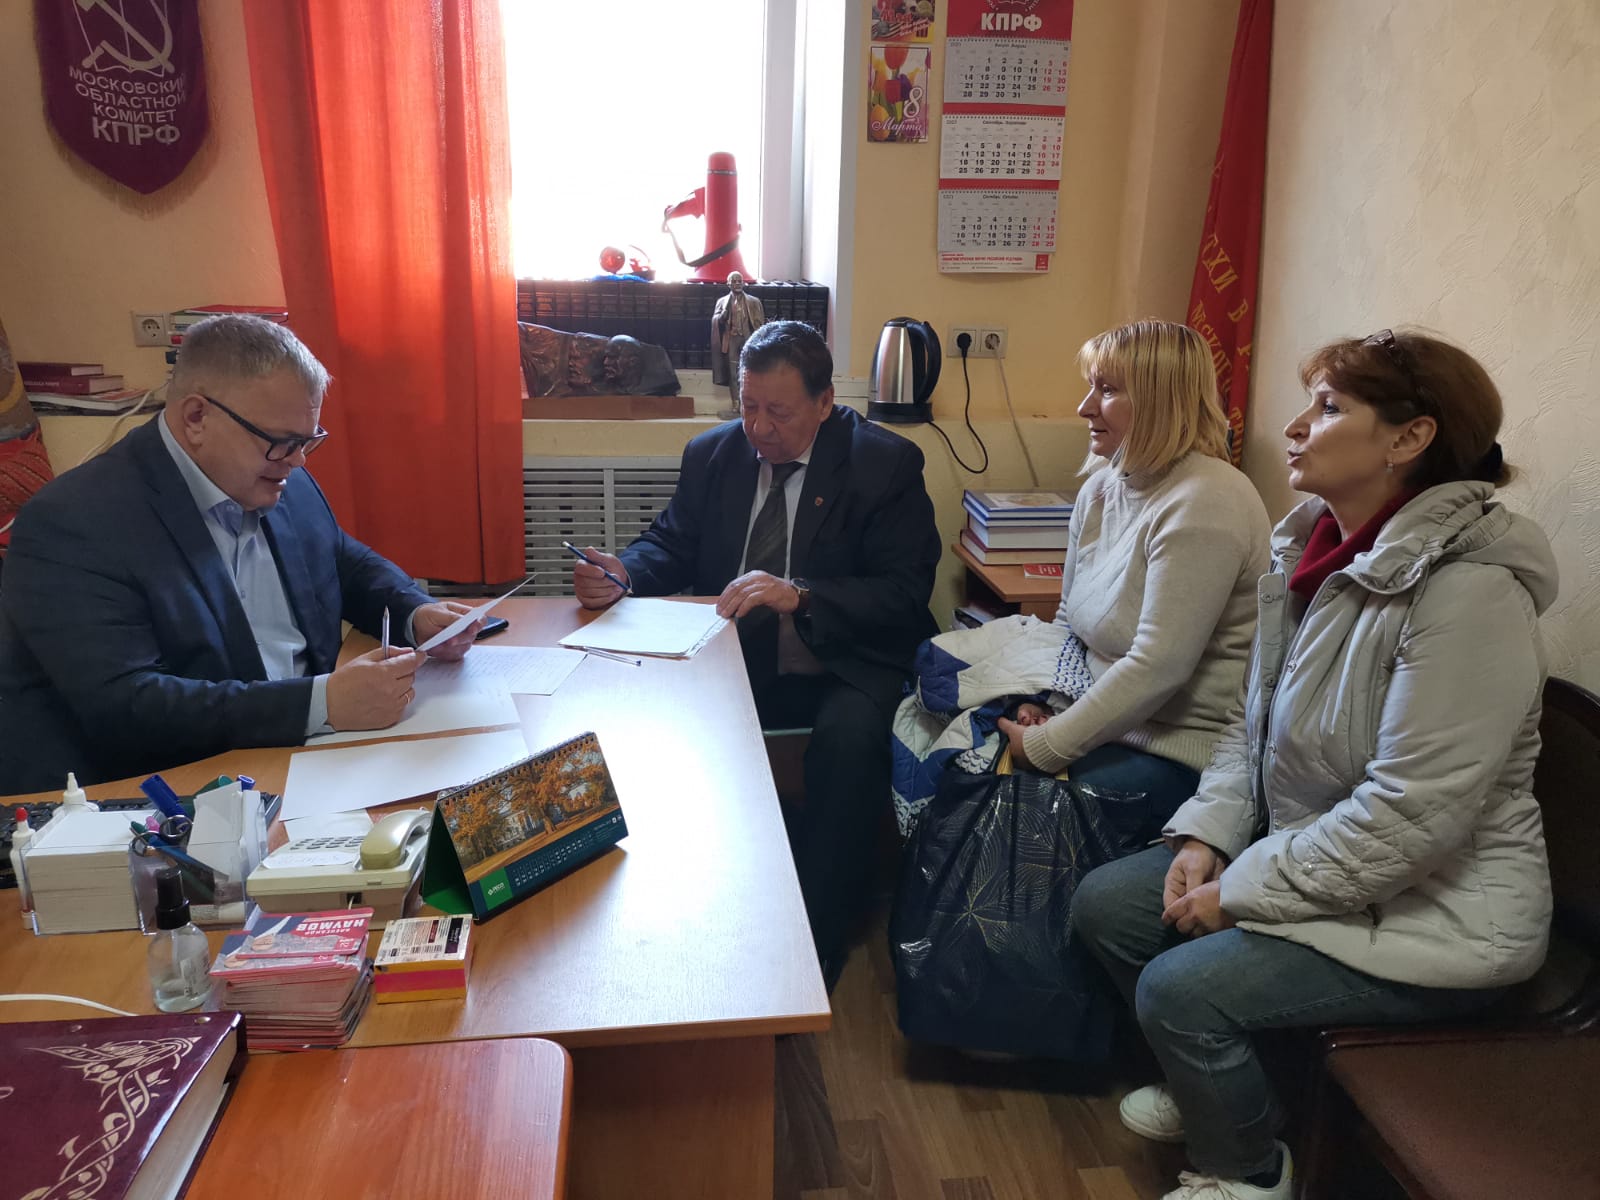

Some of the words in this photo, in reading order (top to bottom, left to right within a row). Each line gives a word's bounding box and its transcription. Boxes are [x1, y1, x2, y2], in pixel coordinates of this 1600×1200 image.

[981, 12, 1042, 32] КПРФ
[903, 86, 923, 119] 8
[93, 103, 176, 123] КОМИТЕТ
[91, 116, 181, 145] КПРФ
[295, 918, 365, 932] НАУМОВ
